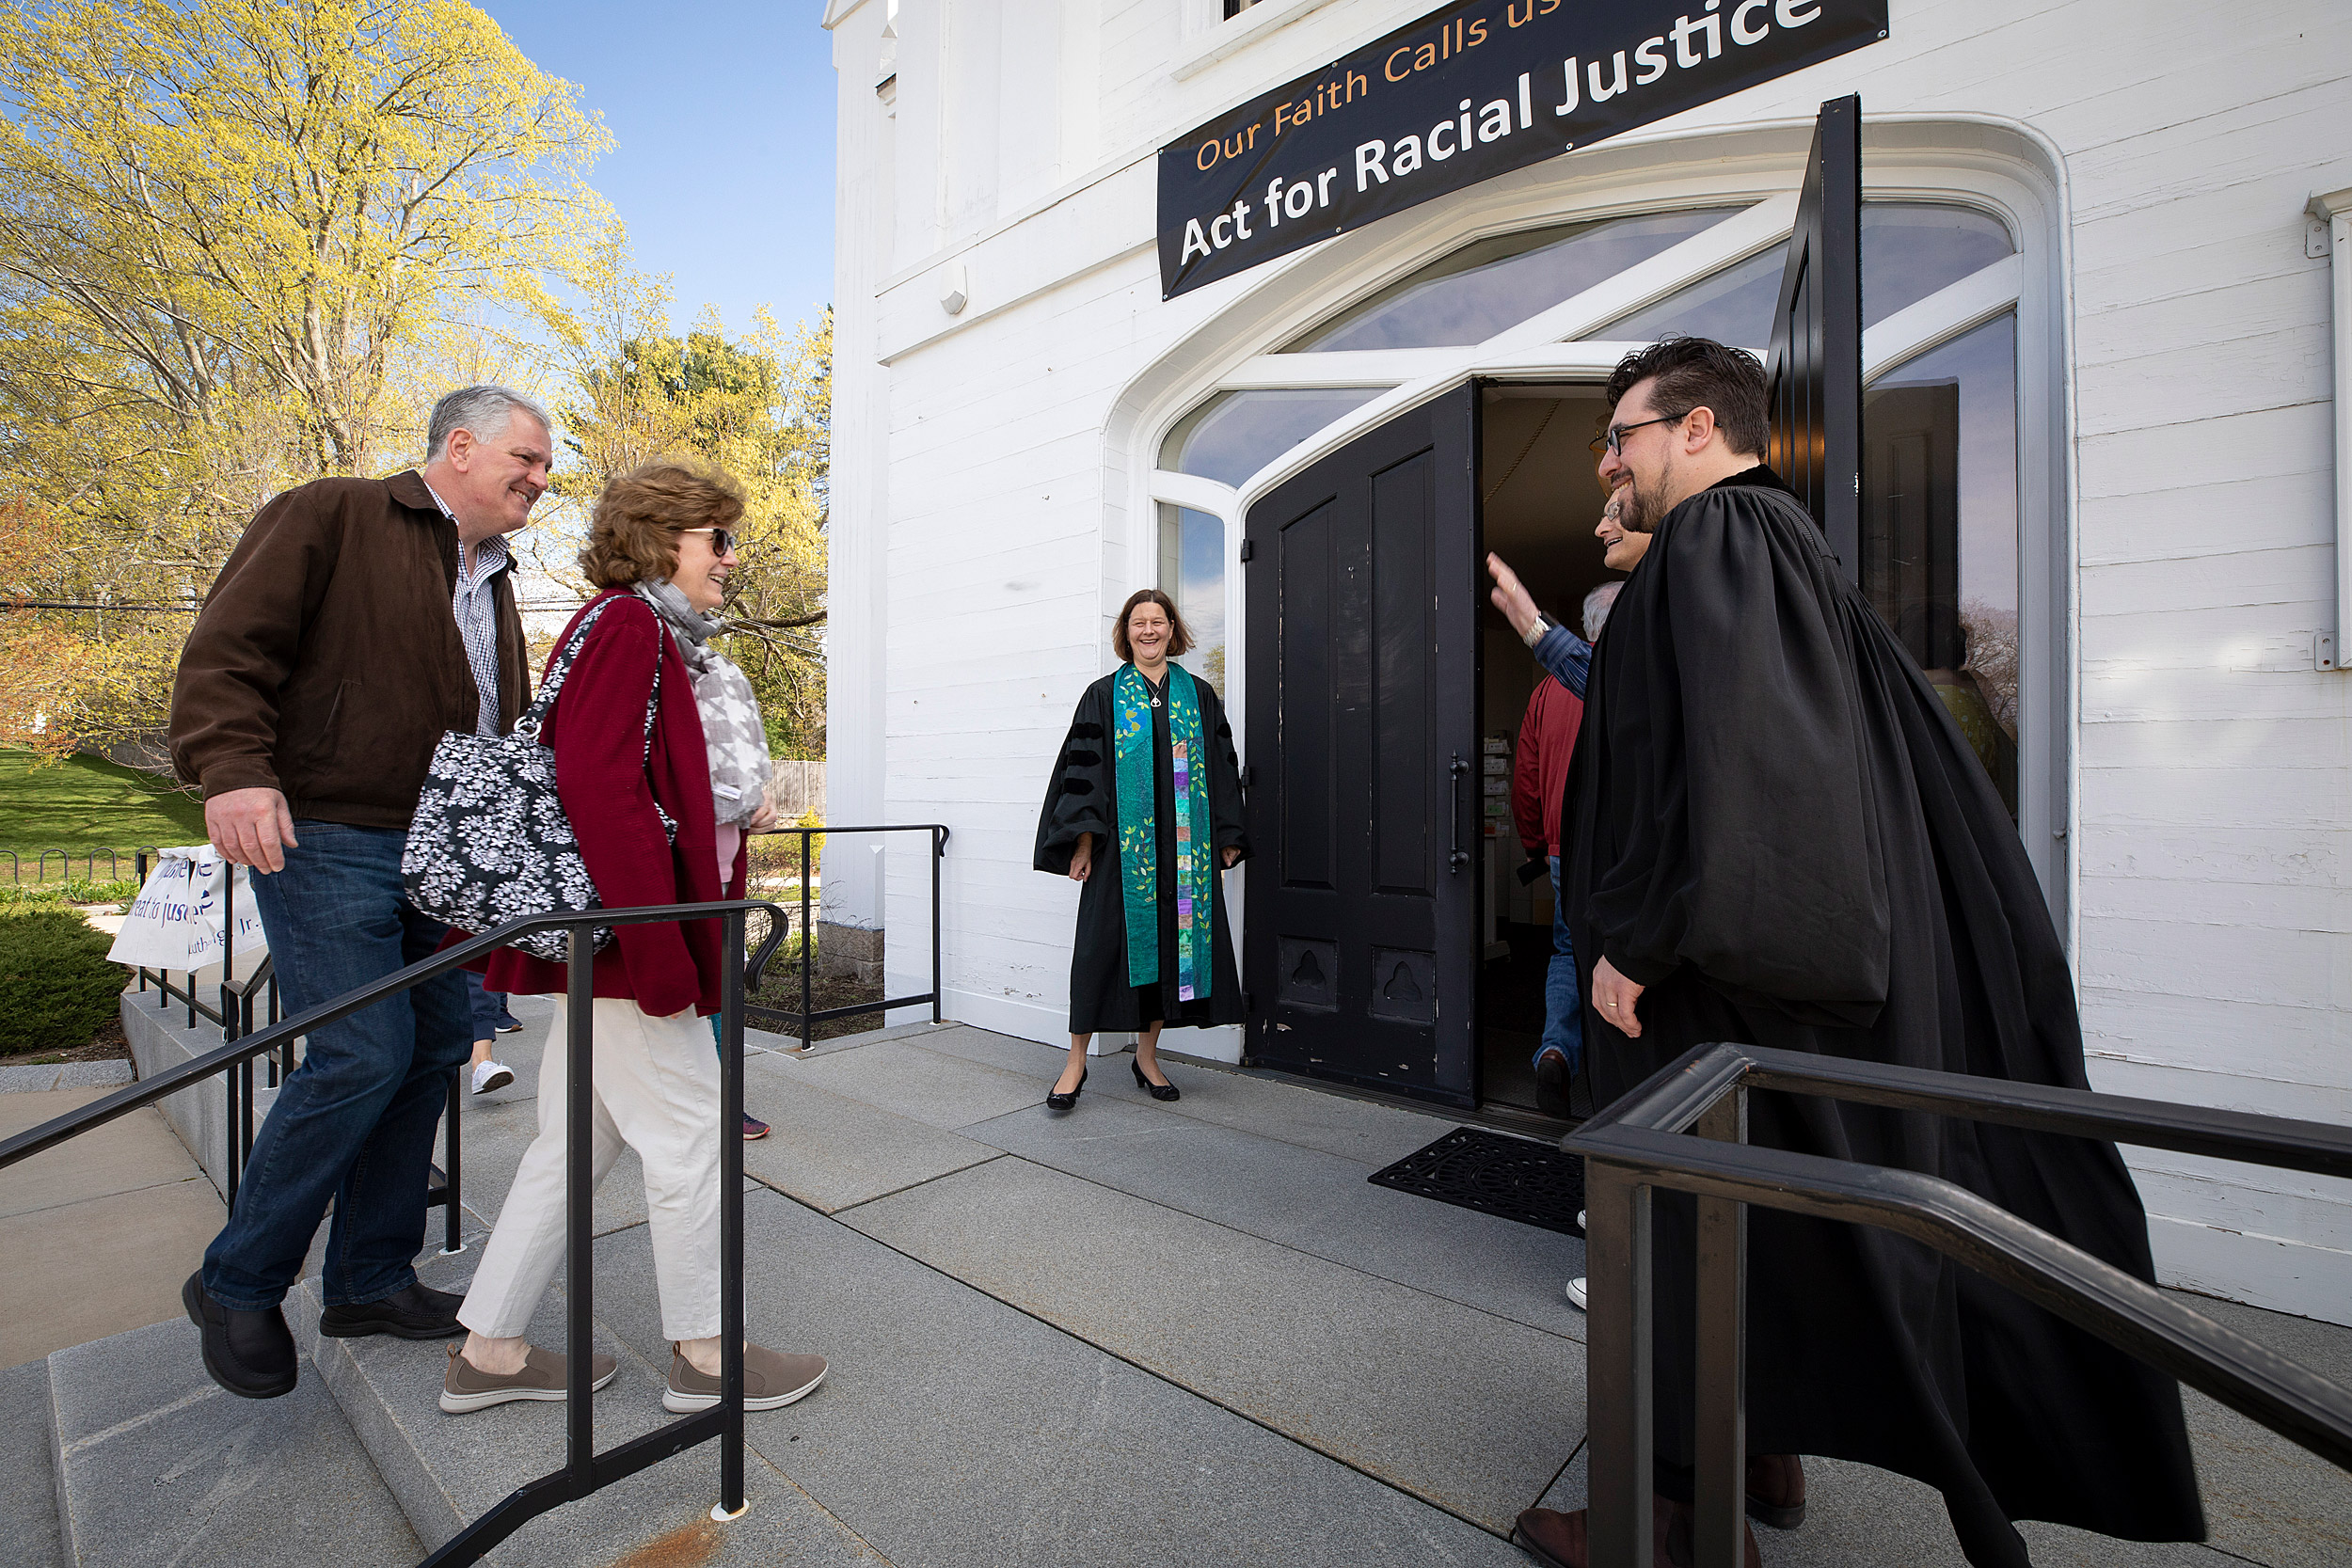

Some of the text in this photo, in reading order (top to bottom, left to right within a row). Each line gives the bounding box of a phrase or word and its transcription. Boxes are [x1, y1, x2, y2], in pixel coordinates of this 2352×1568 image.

[1180, 0, 1821, 266] Act for Racial Justice
[1197, 123, 1261, 171] Our
[1274, 70, 1367, 137] Faith
[1384, 18, 1488, 83] Calls
